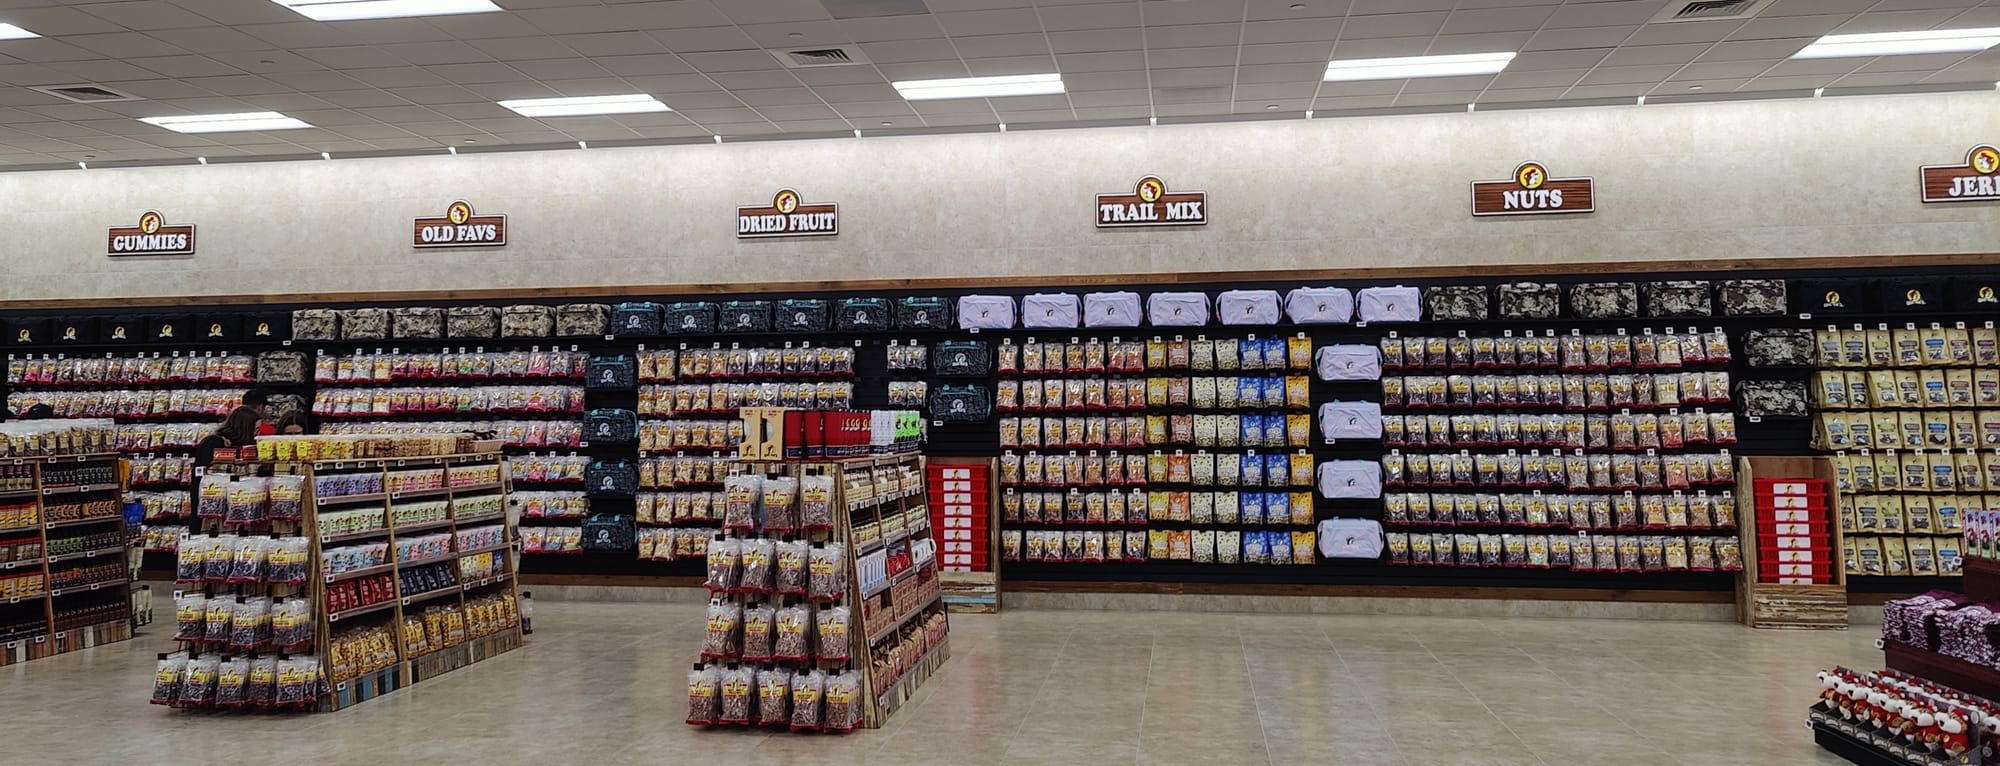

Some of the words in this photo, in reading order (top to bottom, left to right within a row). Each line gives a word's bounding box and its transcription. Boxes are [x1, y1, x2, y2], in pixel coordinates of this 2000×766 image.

[1503, 189, 1563, 210] NUTS
[1100, 203, 1158, 222] TRAIL
[1166, 202, 1203, 220] MIX
[739, 214, 787, 233] DRIED
[789, 212, 835, 231] FRUIT
[113, 233, 187, 252] GUMMIES
[422, 225, 454, 243] OLD
[457, 224, 497, 242] FAVS
